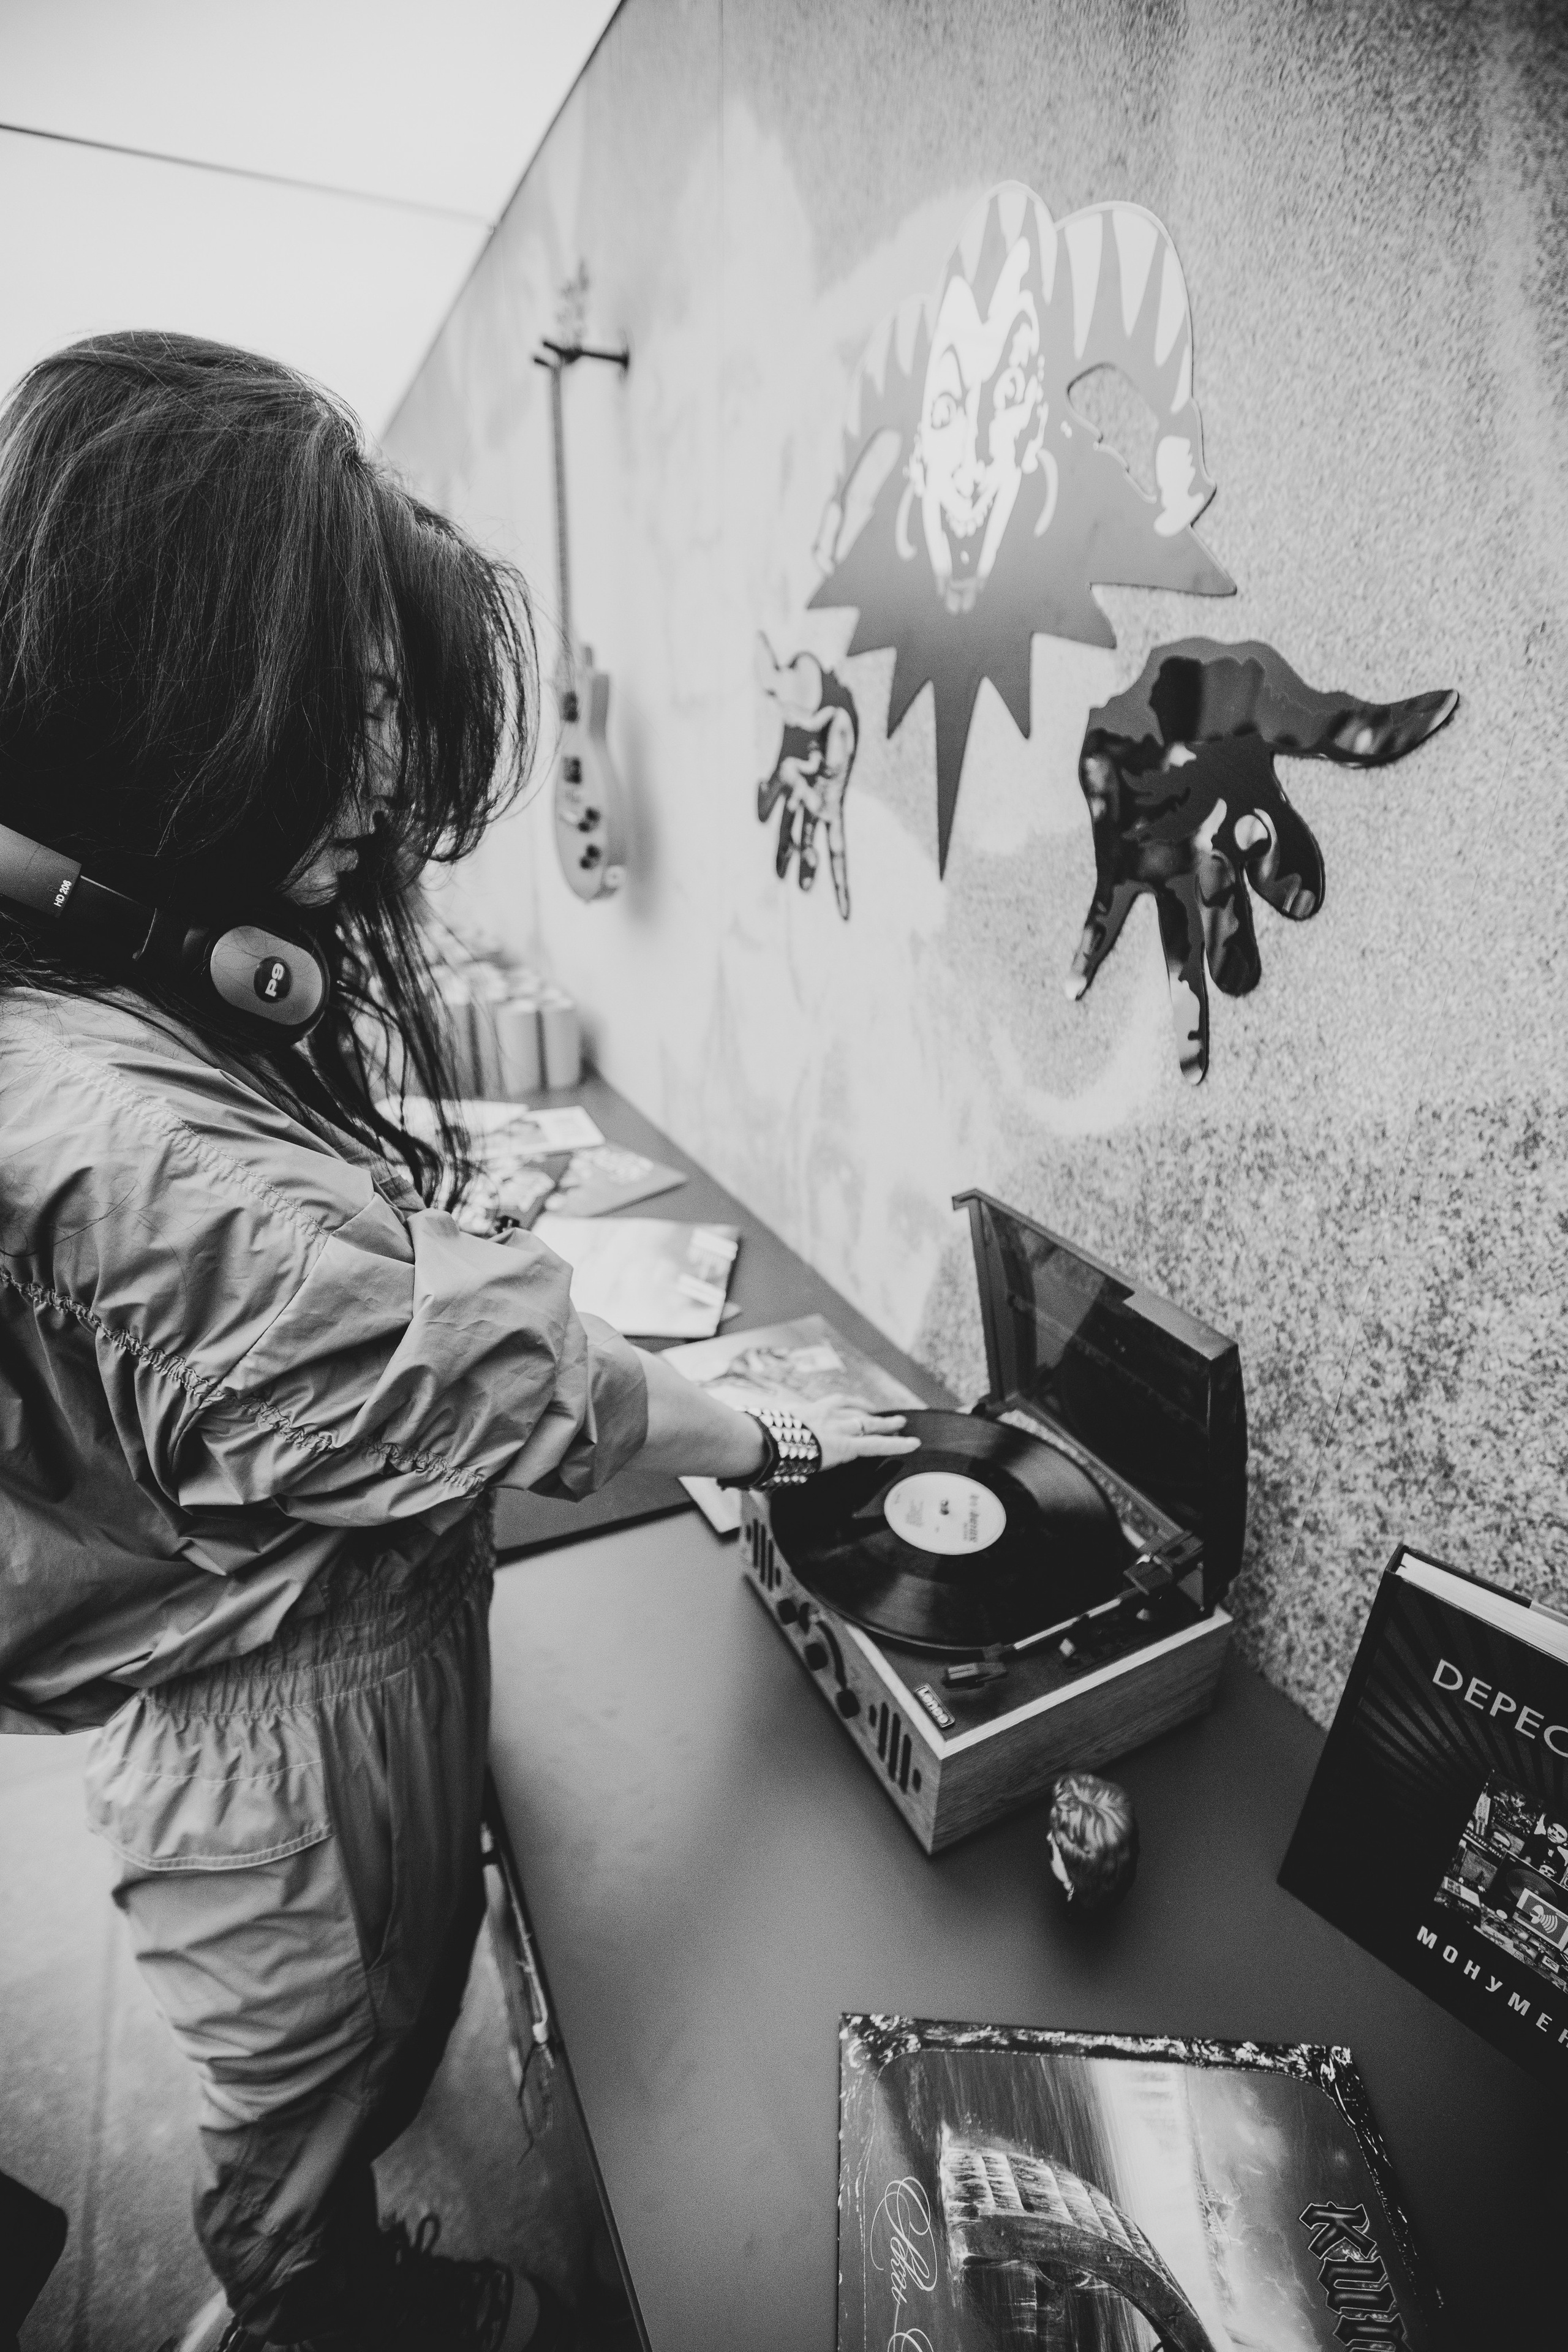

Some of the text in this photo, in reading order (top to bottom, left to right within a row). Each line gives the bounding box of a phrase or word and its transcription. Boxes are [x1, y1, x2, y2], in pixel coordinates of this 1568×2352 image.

[54, 880, 72, 907] HD 206
[265, 963, 284, 997] P9
